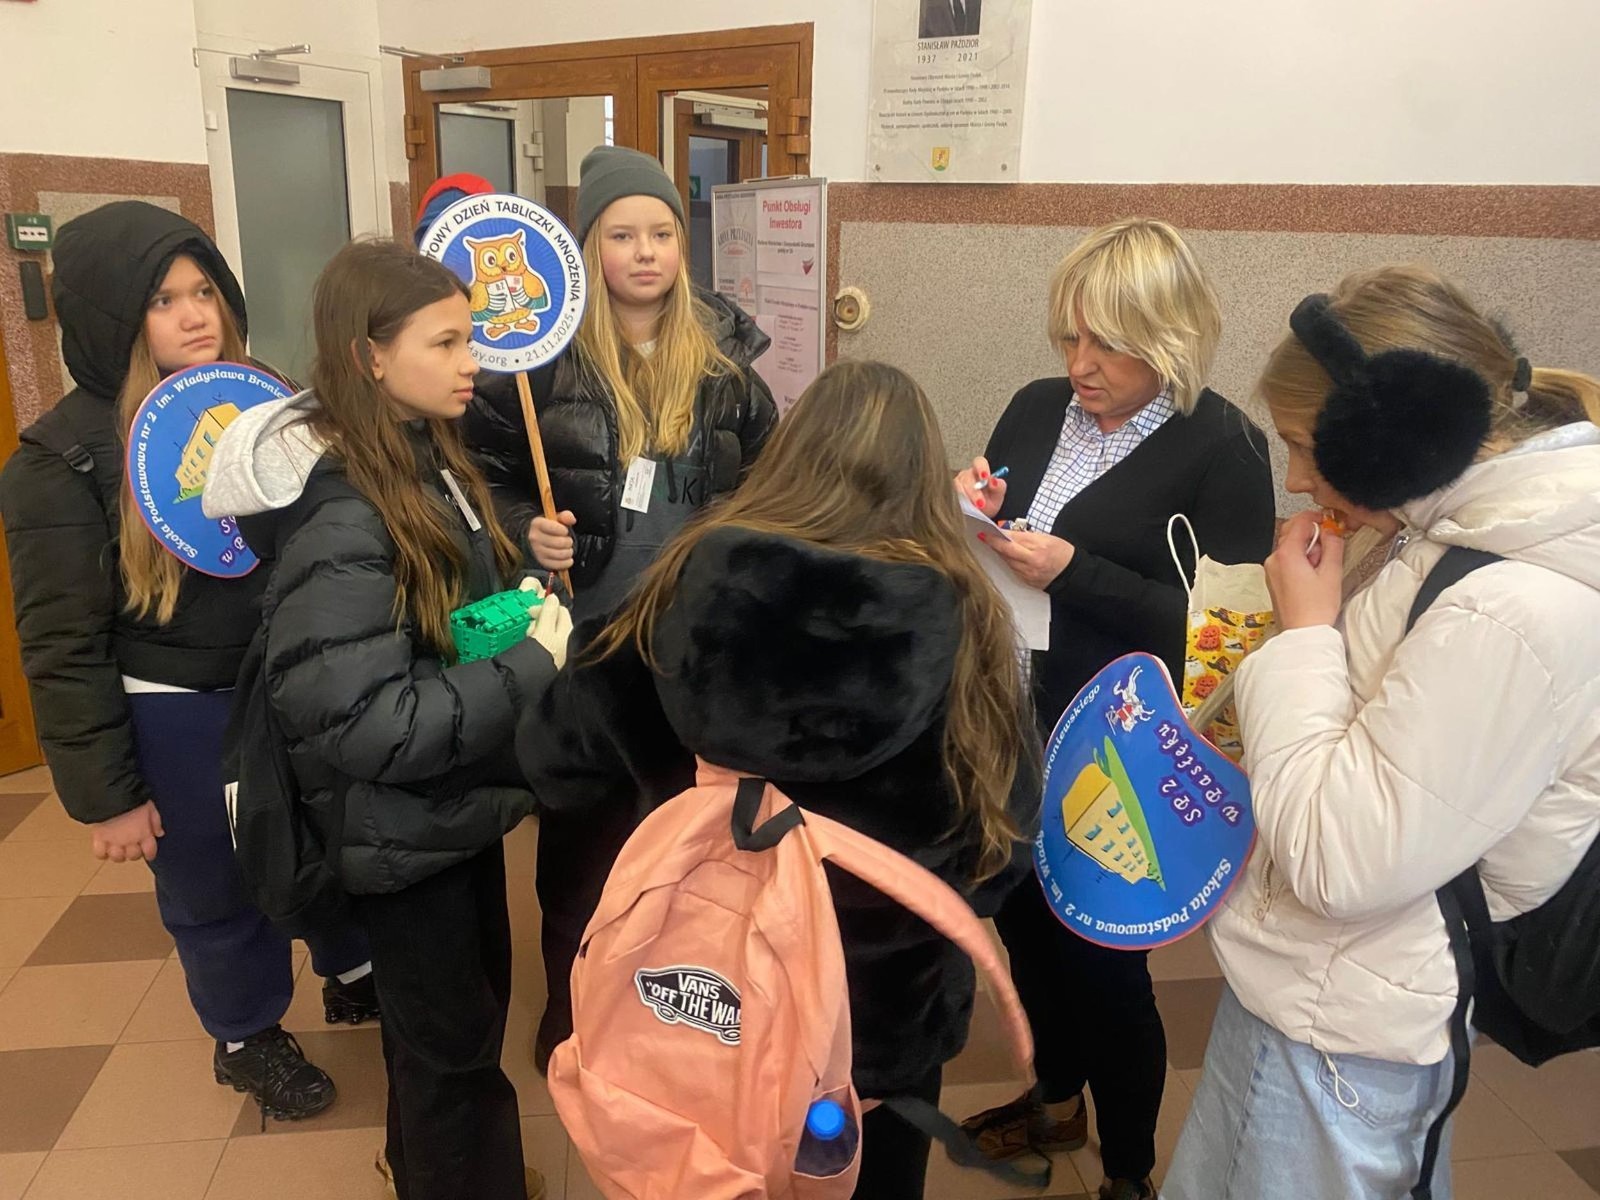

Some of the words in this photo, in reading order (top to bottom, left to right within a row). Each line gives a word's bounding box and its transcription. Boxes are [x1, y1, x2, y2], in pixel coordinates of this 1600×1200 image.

[917, 40, 950, 51] STANISŁAW
[917, 53, 937, 64] 1937
[957, 52, 978, 63] 2021
[762, 200, 783, 213] Punkt
[783, 199, 811, 215] Obsługi
[769, 217, 803, 230] Inwestora
[453, 199, 490, 225] DZIEŃ
[496, 201, 556, 233] TABLICZKI
[553, 233, 581, 302] MNOŻENIA
[524, 313, 575, 362] 21.11.2025
[172, 368, 246, 394] Władysława
[248, 373, 287, 399] Bronie
[155, 393, 176, 410] im.
[146, 411, 158, 424] 2
[140, 422, 152, 441] nr
[136, 442, 164, 524] Podstawowa
[160, 523, 199, 559] Szkoła
[1161, 778, 1178, 794] 2
[1173, 794, 1202, 823] SP
[1222, 804, 1240, 823] w
[1050, 877, 1064, 904] im.
[1189, 858, 1232, 911] Szkoła
[1064, 902, 1077, 916] 2
[1075, 912, 1092, 927] nr
[1094, 911, 1191, 936] Podstawowa
[678, 972, 722, 1000] VANS
[680, 991, 711, 1020] THE
